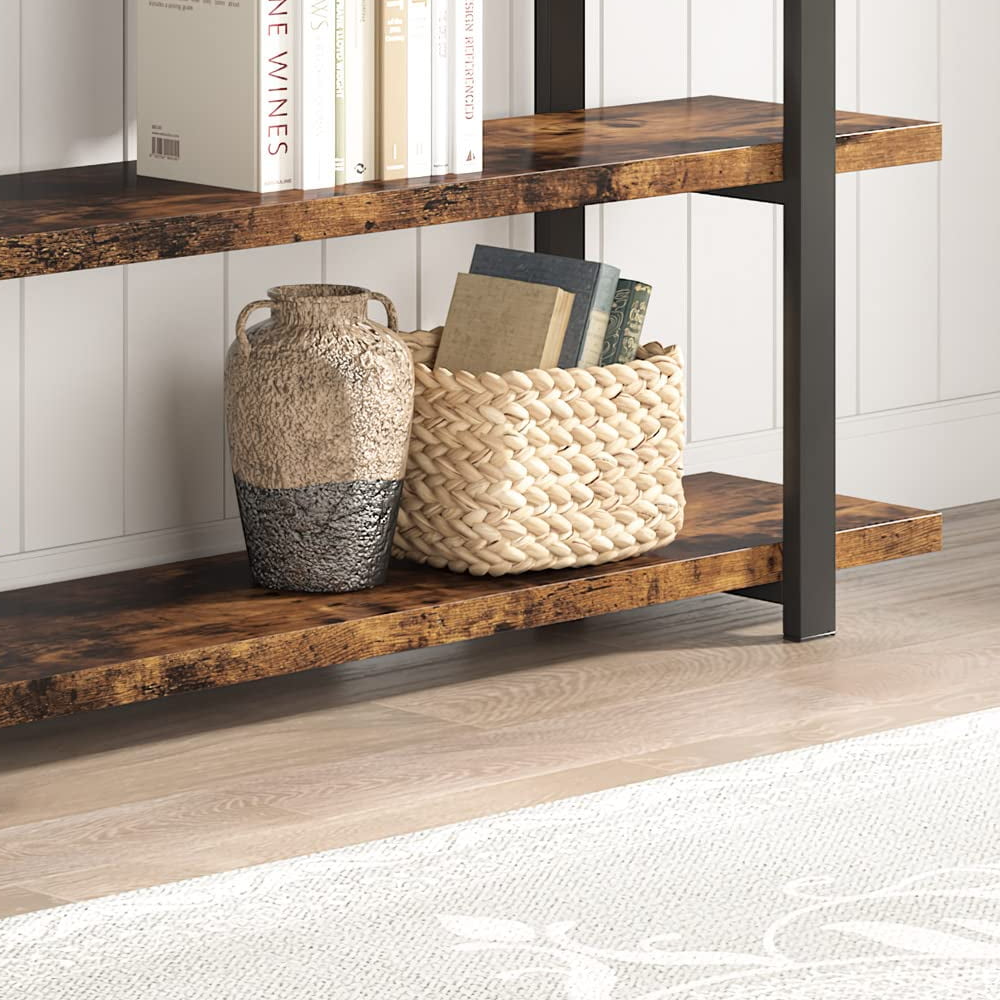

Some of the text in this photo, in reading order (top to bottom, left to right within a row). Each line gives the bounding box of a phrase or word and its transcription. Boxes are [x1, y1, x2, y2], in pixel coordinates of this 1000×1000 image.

[336, 30, 344, 60] LLOYD
[464, 36, 474, 120] REFERENCED
[267, 50, 288, 156] WINES
